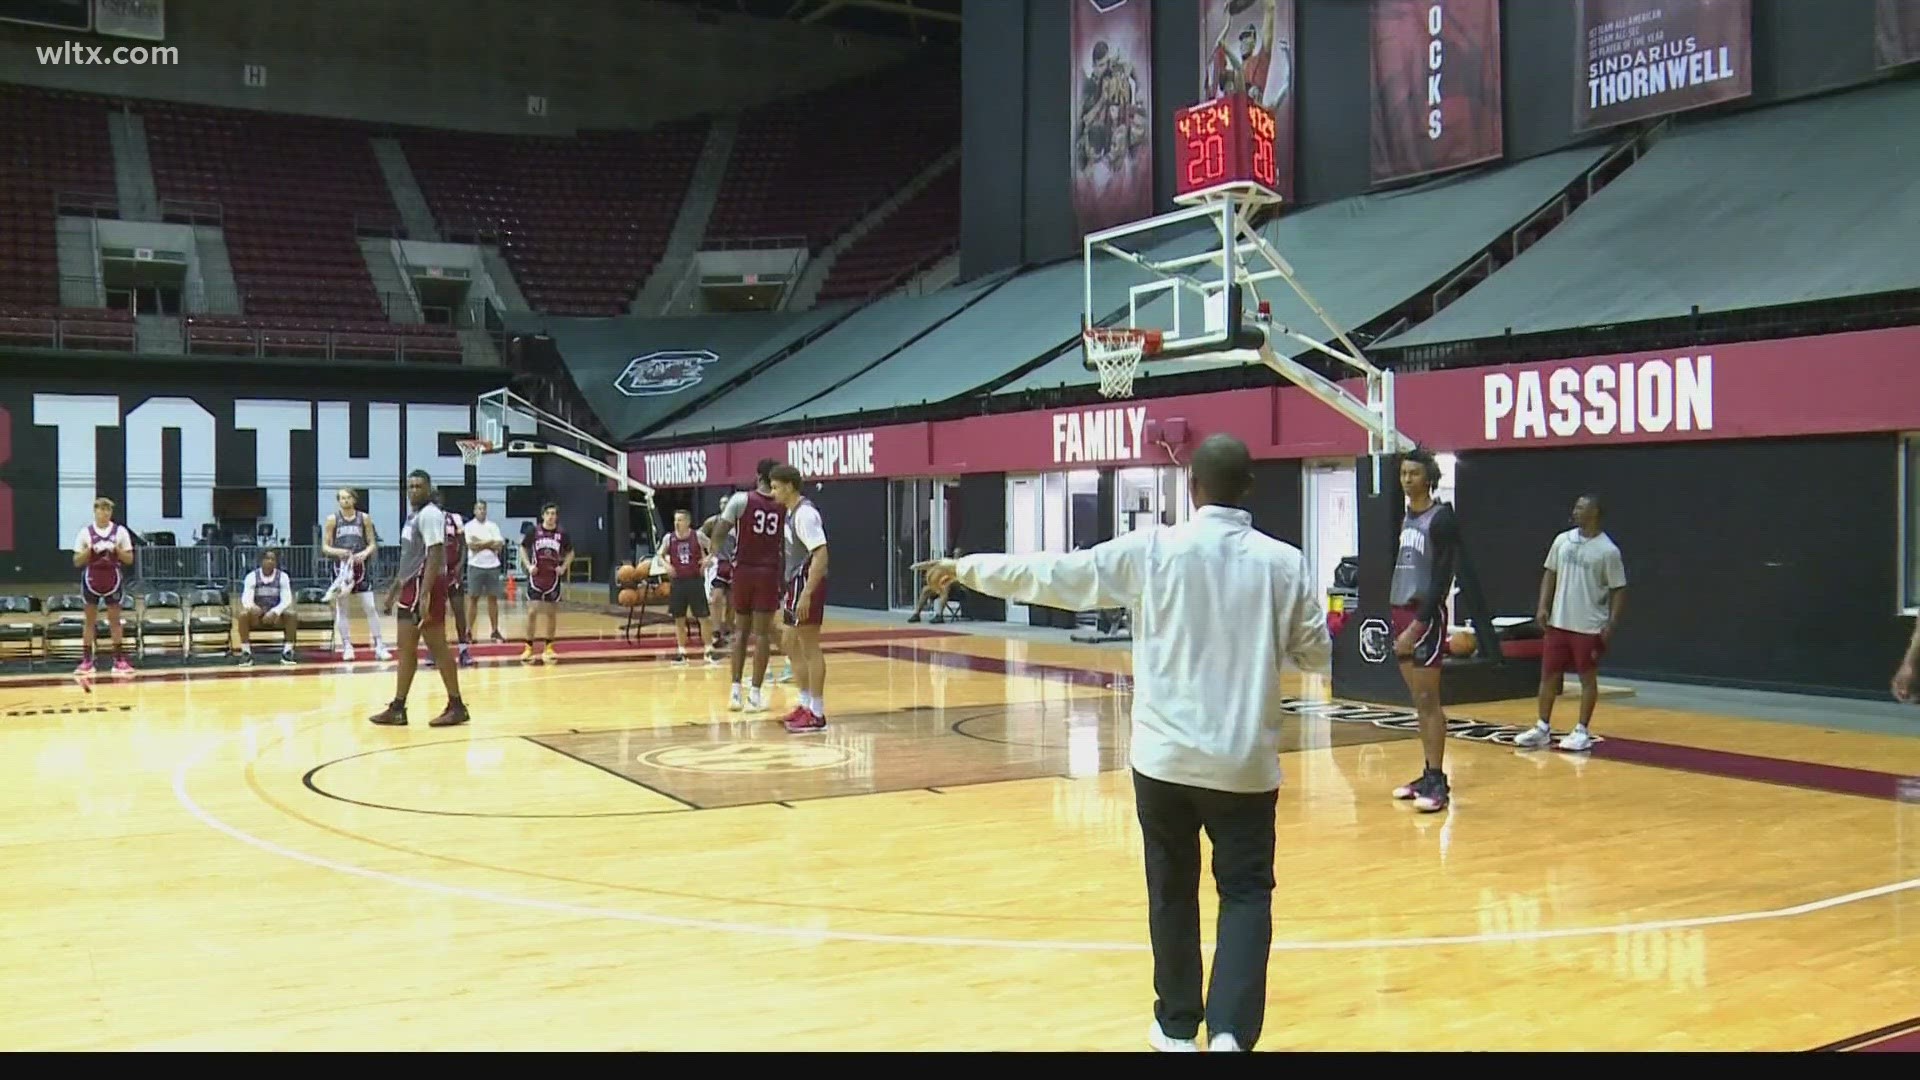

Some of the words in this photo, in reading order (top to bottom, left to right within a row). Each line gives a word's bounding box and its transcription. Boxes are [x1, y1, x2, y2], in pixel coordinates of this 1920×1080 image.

[1588, 47, 1734, 109] THORNWELL
[1589, 37, 1697, 78] SINDARIUS
[1179, 104, 1230, 139] 47:24
[1188, 134, 1224, 185] 20
[1254, 133, 1274, 185] 20
[1484, 355, 1713, 441] PASSION
[787, 432, 874, 477] DISCIPLINE
[1053, 406, 1146, 463] FAMILY
[33, 393, 216, 551] TO
[644, 449, 707, 486] TOUGHNESS
[753, 509, 779, 536] 33
